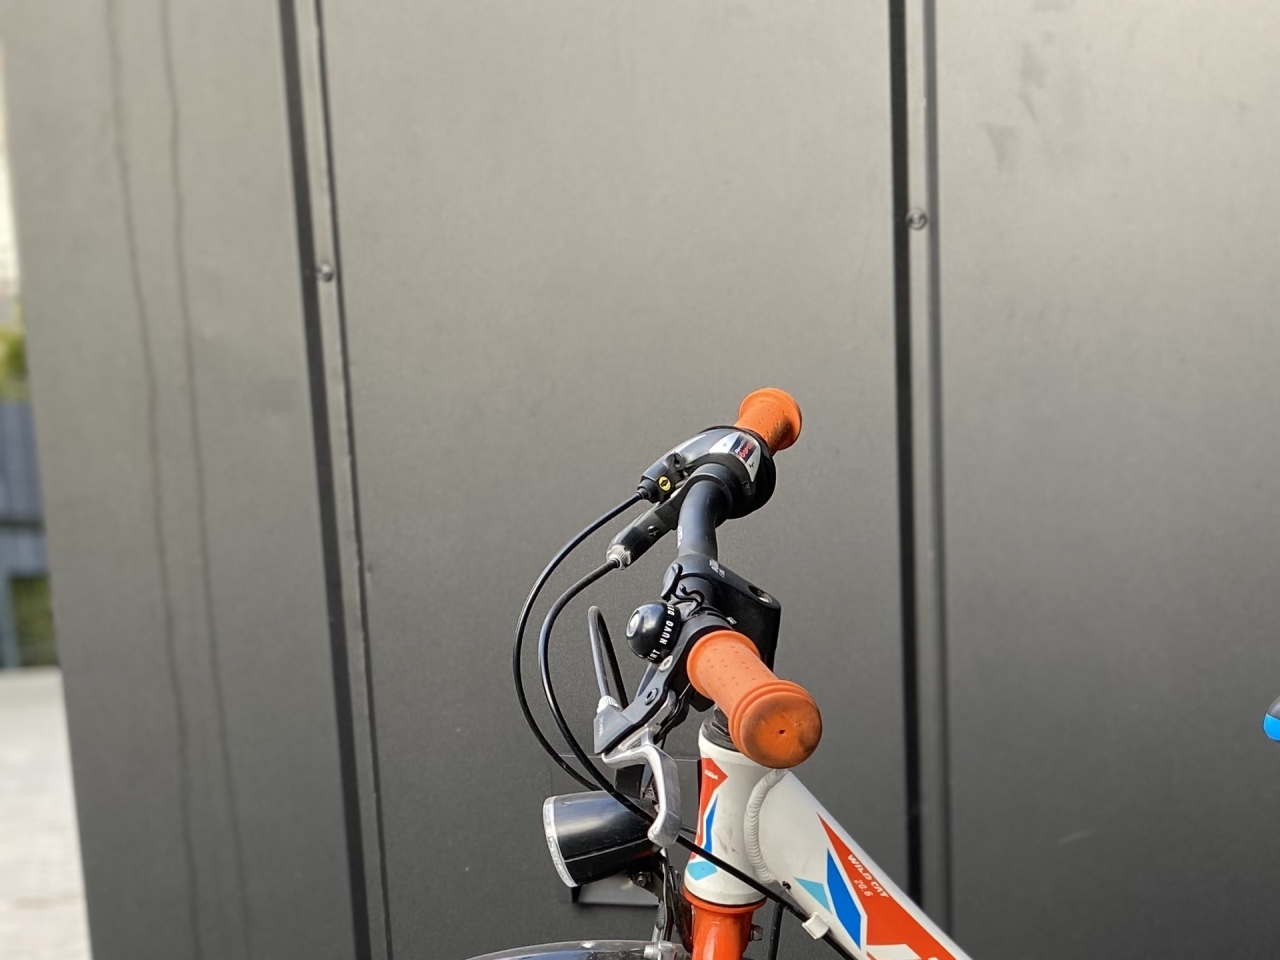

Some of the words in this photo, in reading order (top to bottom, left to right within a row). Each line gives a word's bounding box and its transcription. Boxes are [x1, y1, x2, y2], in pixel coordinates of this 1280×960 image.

[659, 620, 674, 645] NUVO
[847, 854, 873, 881] WILD
[870, 881, 890, 898] CAT
